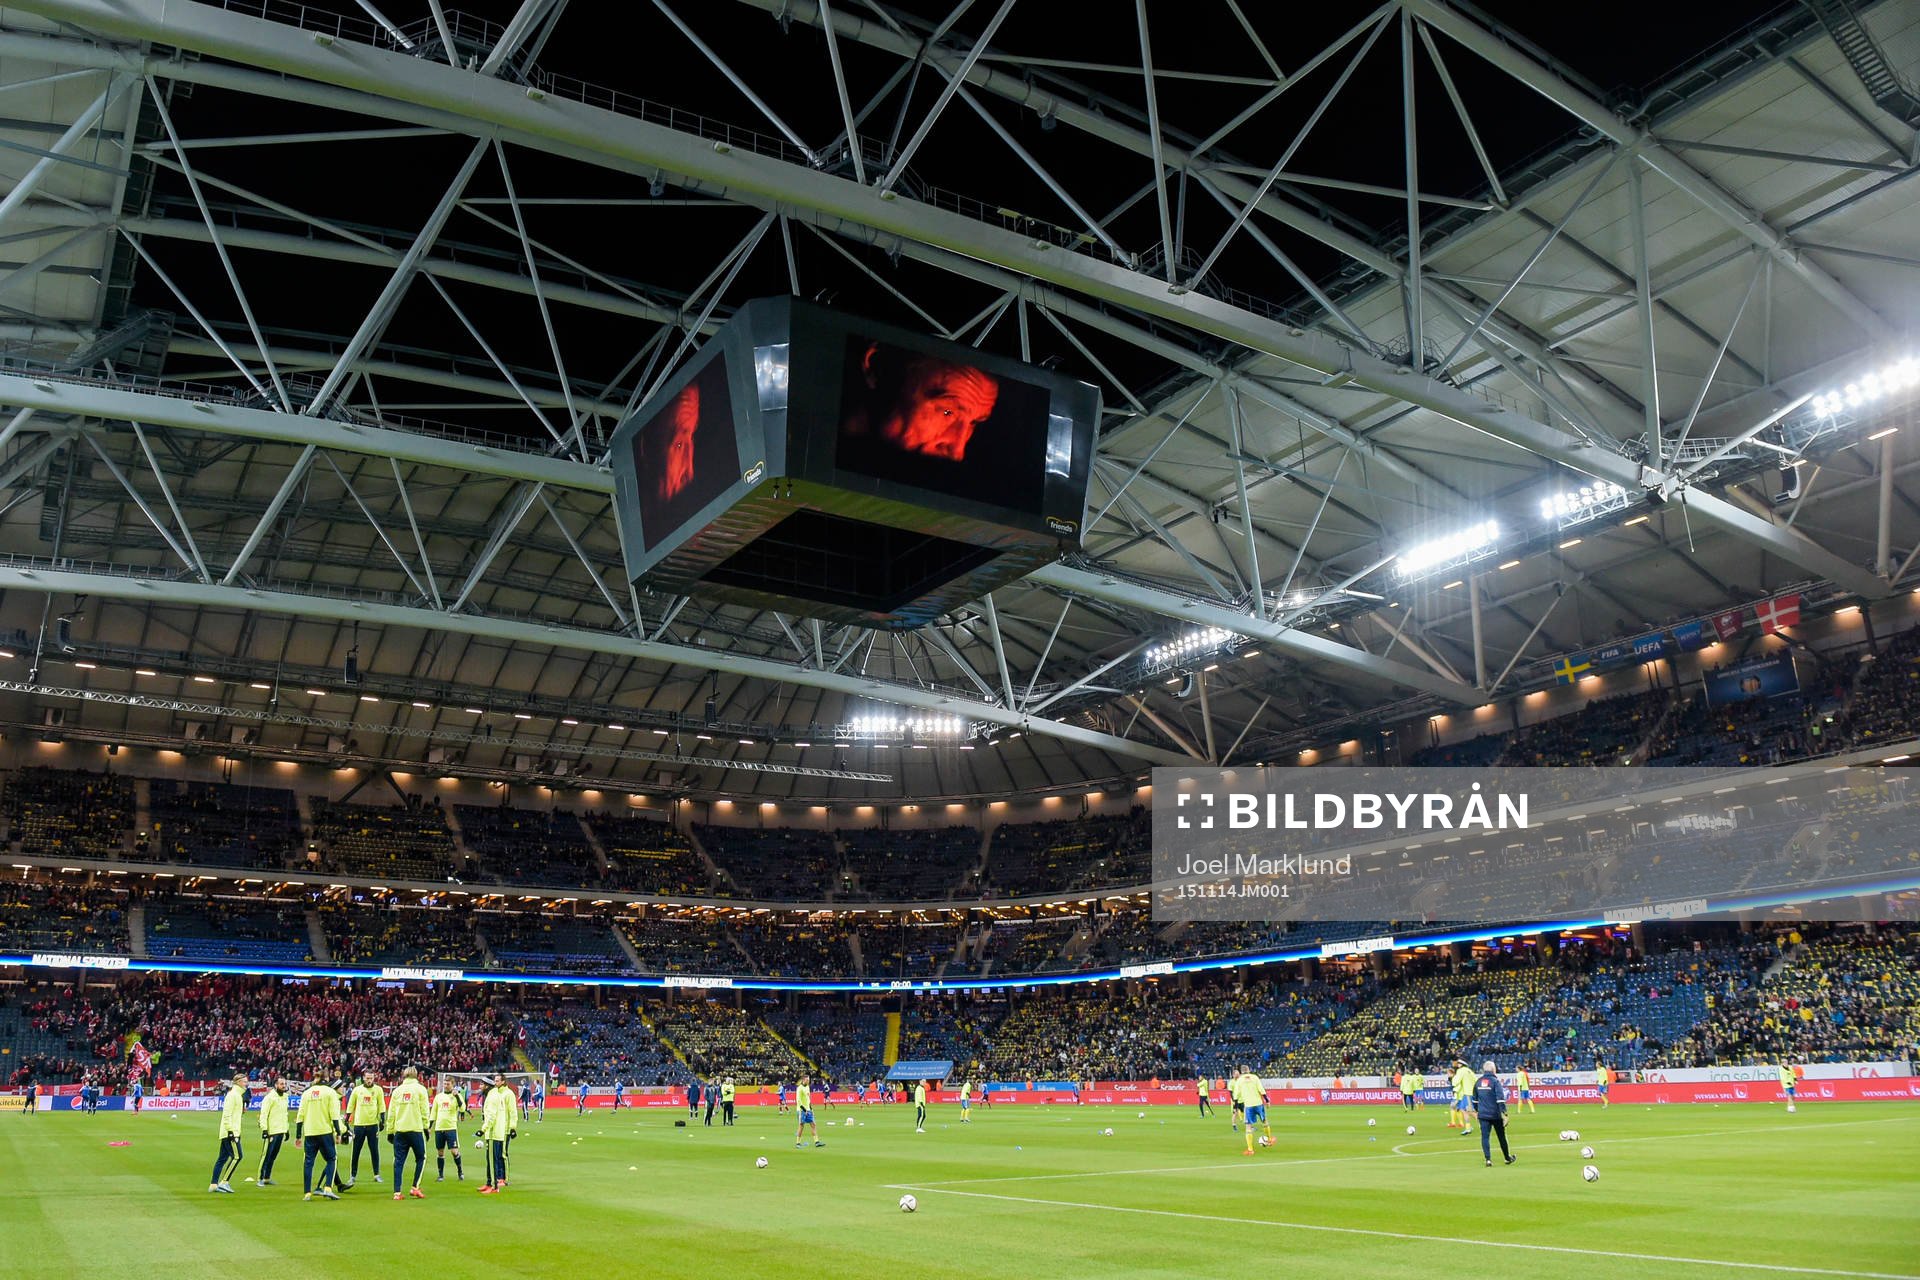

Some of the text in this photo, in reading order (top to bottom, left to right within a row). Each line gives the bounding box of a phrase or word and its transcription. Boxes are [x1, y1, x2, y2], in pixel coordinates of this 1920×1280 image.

[1601, 647, 1619, 660] FIFA
[1634, 641, 1661, 656] UEFA
[32, 954, 130, 969] NATIONALSPORTEN
[382, 967, 464, 980] NATIONALSPORTEN
[891, 981, 912, 989] 00:00
[1645, 1073, 1667, 1083] ICA
[1852, 1066, 1881, 1078] ICA
[1331, 1091, 1402, 1101] EUROPEAN QUALIFIERS
[1424, 1090, 1446, 1100] UEFA
[1512, 1088, 1601, 1099] EOPEAN QUALIFIER
[148, 1097, 191, 1109] elkedjan
